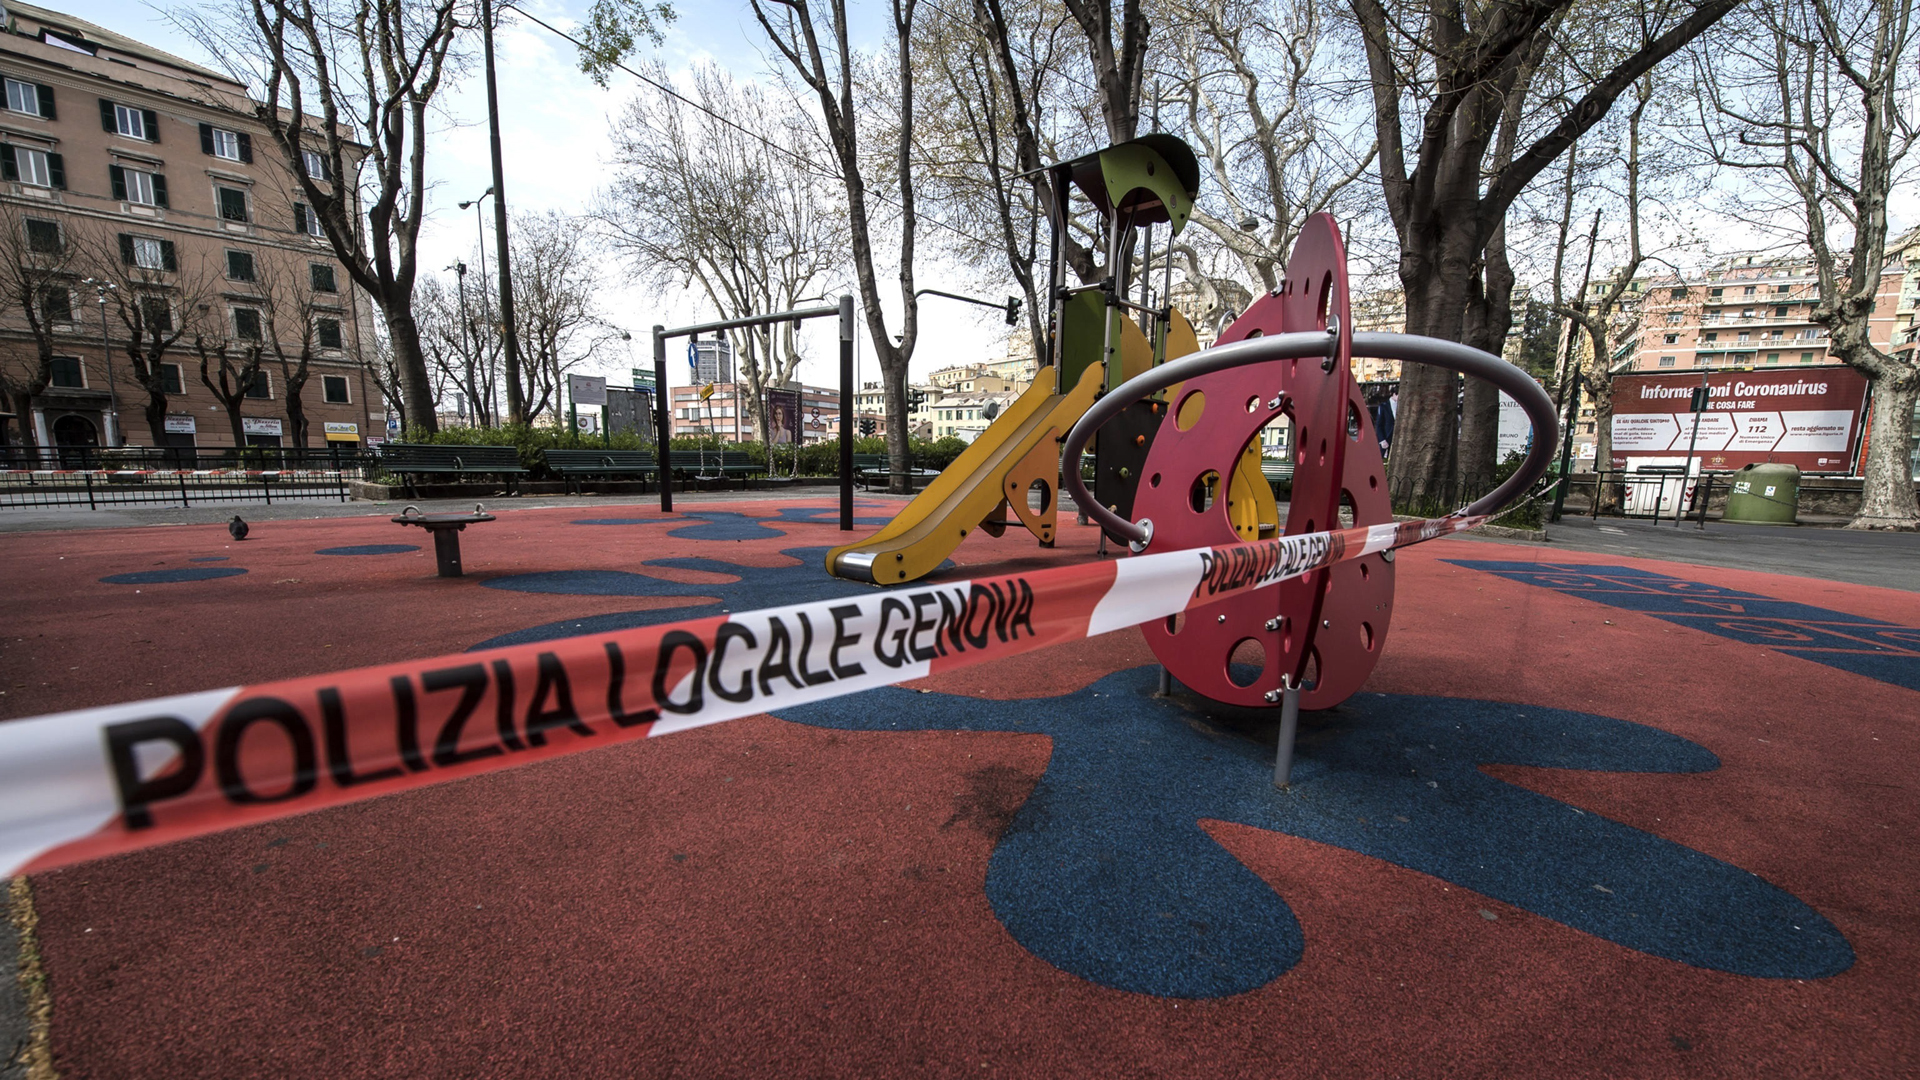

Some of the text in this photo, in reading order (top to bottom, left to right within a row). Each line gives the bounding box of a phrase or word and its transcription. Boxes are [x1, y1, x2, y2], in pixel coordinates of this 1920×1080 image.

[1641, 379, 1828, 399] Informaoni Coronavirus
[1716, 401, 1736, 410] COSA
[1737, 400, 1756, 409] FARE
[1196, 533, 1346, 598] POLIZIA LOCALE GENOVA
[104, 577, 1036, 831] POLIZIA LOCALE GENOVA
